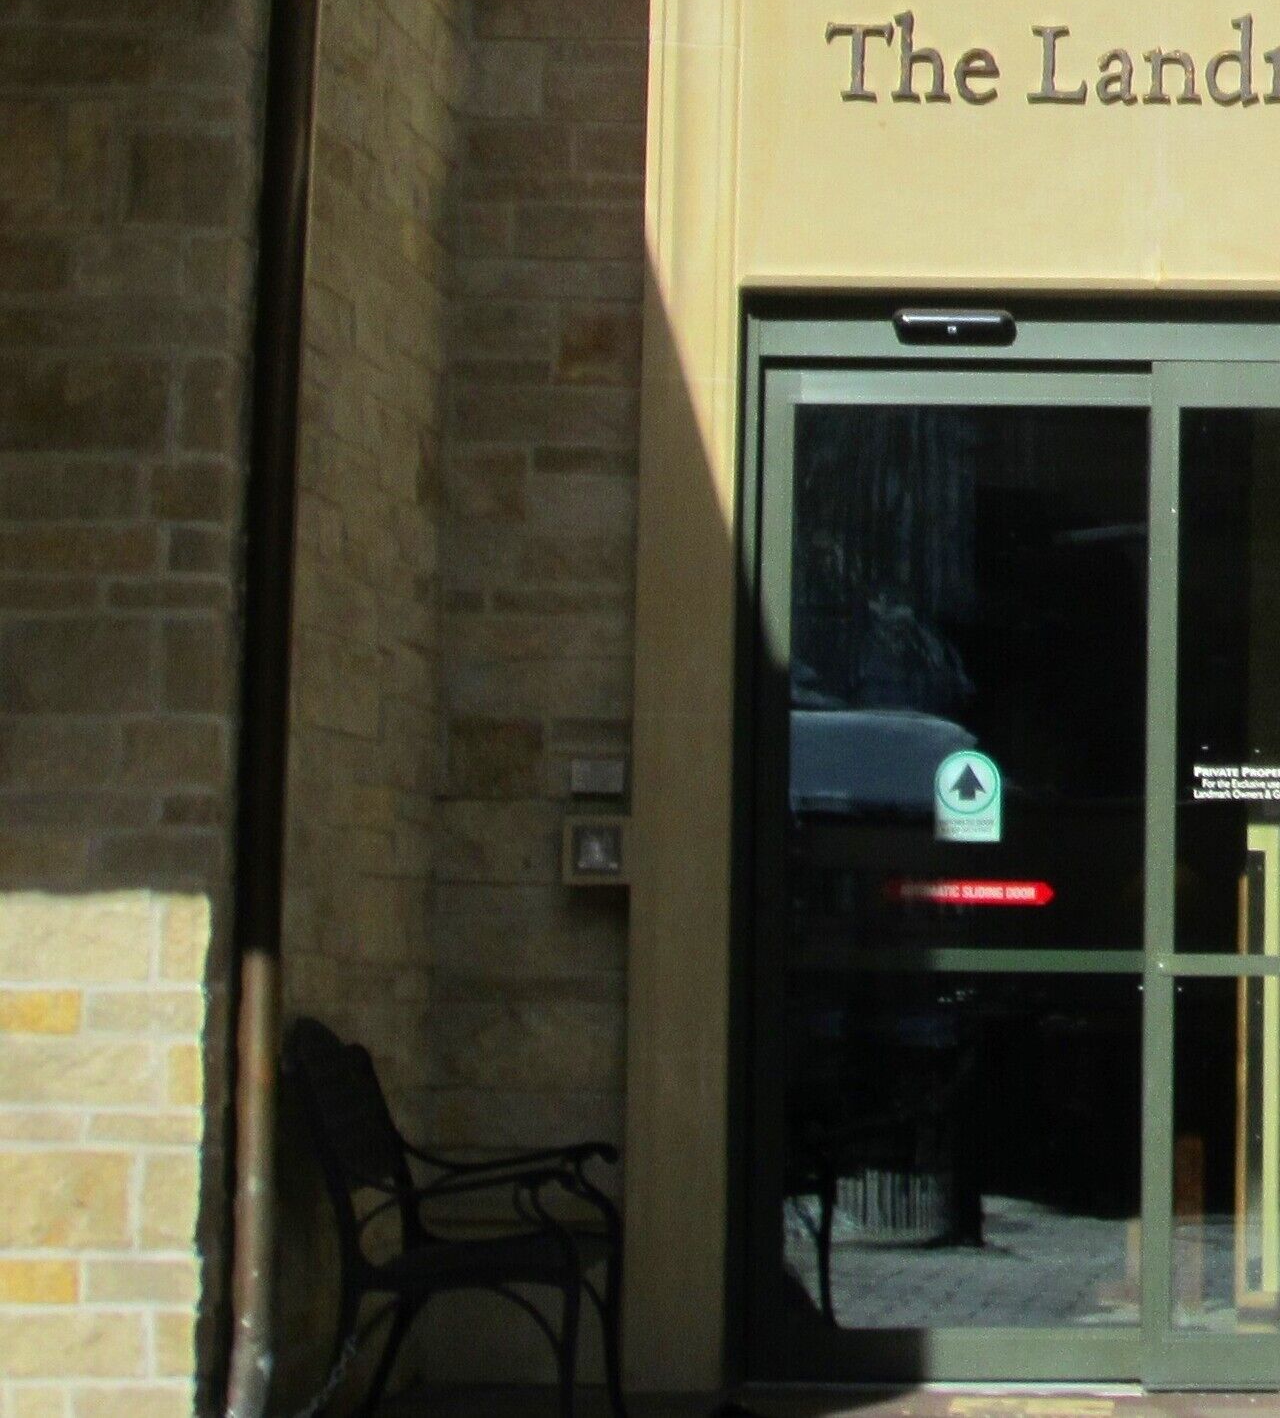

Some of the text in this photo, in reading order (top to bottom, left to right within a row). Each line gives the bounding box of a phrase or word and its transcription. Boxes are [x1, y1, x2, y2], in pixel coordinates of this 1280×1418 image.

[825, 10, 1001, 105] The
[1193, 766, 1239, 778] PRIVATE
[1005, 886, 1036, 900] DOOR
